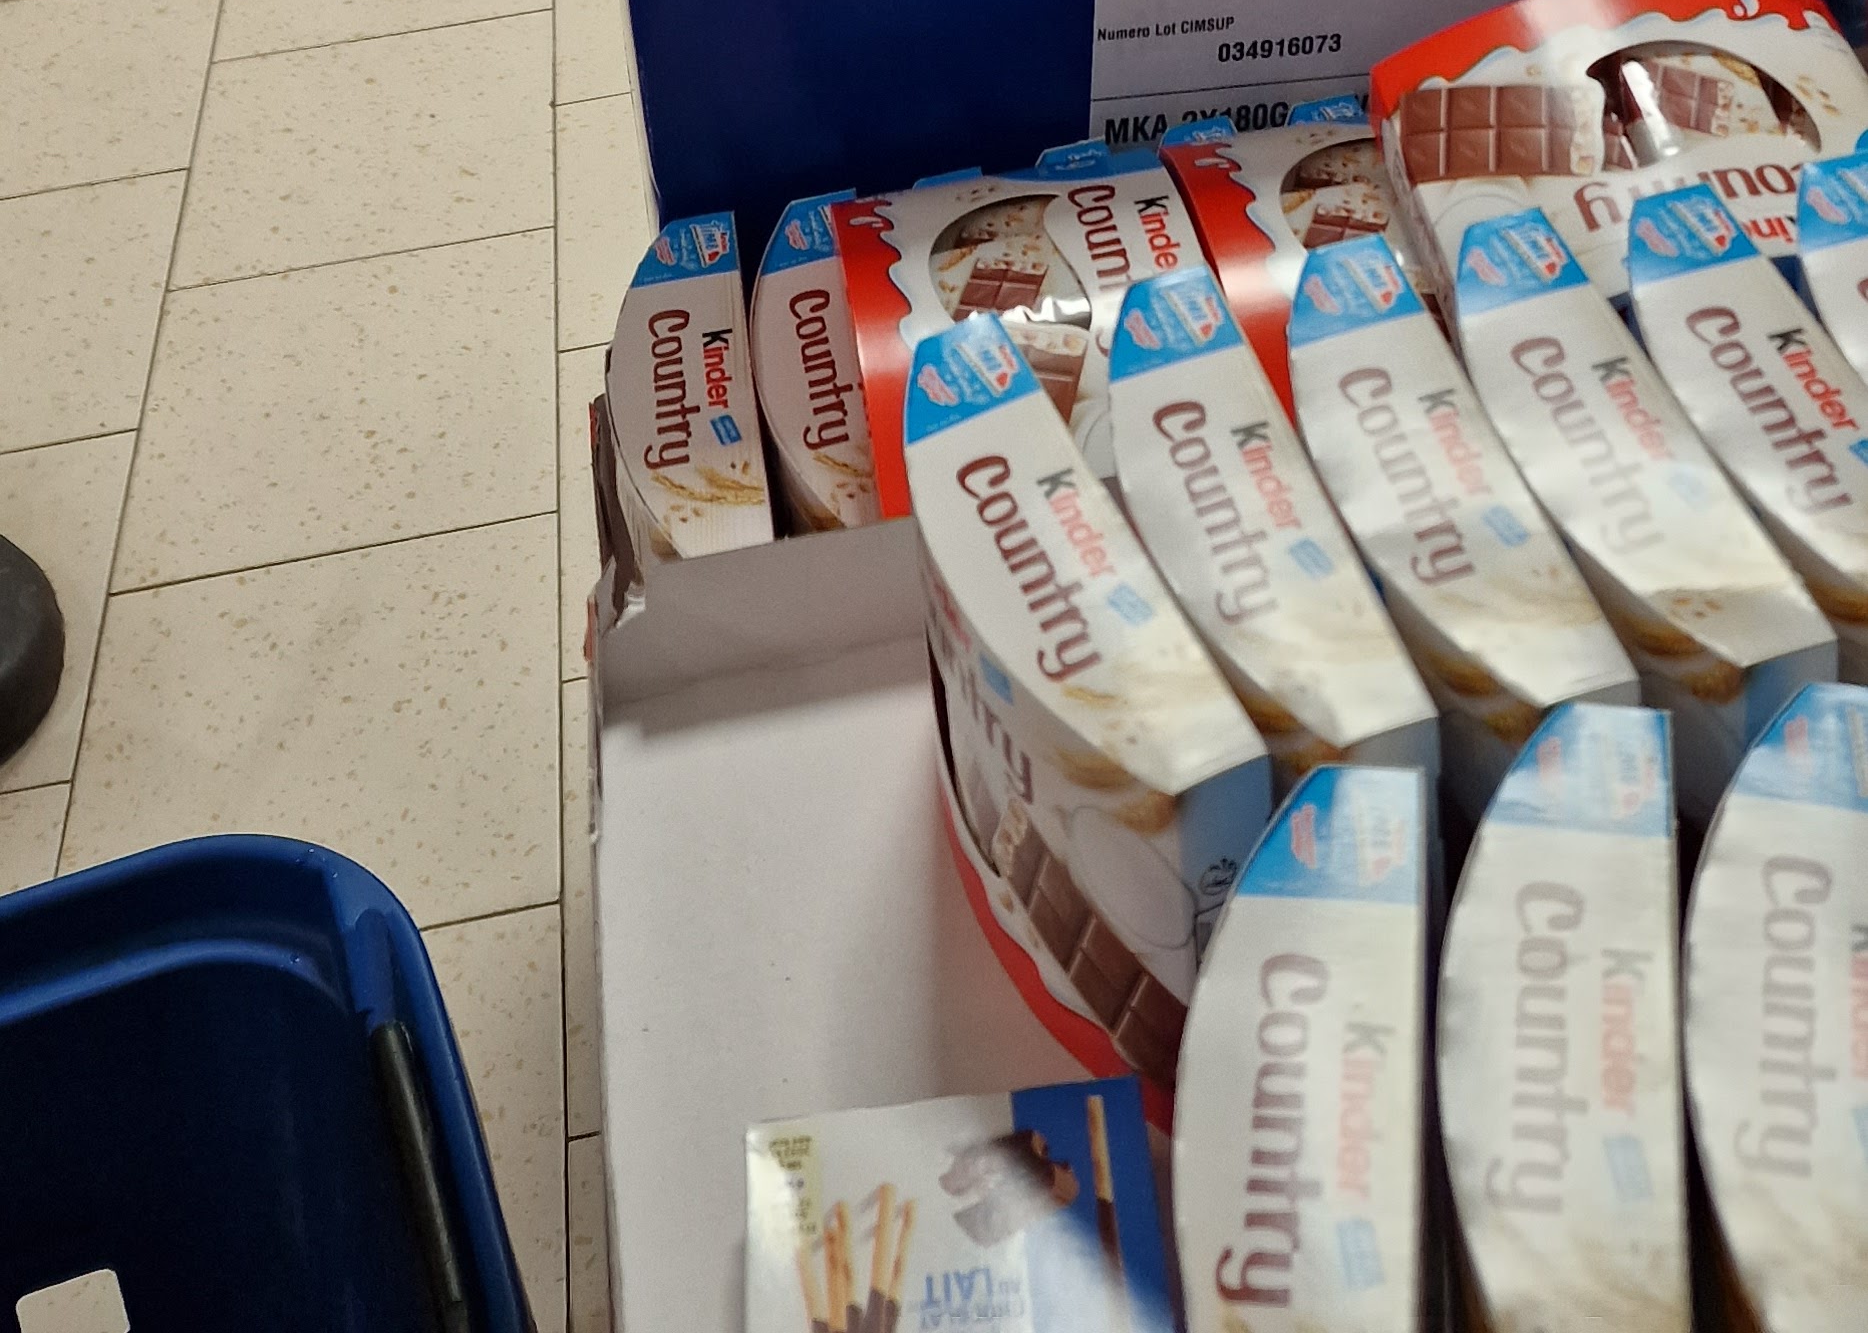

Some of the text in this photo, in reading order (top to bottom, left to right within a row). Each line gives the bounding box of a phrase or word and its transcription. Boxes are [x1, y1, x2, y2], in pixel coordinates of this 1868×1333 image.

[1096, 15, 1236, 42] Numero Lot CIMSUP
[1217, 32, 1343, 63] 034916073
[1104, 113, 1169, 146] MKA
[1133, 194, 1182, 271] Kinde
[643, 308, 701, 471] Country
[701, 328, 734, 410] Kinder
[788, 288, 855, 451] Country
[1591, 355, 1676, 462] Kinder
[1685, 304, 1854, 516] Country
[1767, 327, 1858, 433] Kinder
[1229, 421, 1302, 531] Kinder
[1337, 365, 1477, 587] Country
[1417, 387, 1492, 499] Kinder
[956, 454, 1104, 684] Country
[1035, 467, 1118, 580] Kinder
[1153, 400, 1279, 629] Country
[1485, 879, 1588, 1215] Country
[1215, 952, 1331, 1309] Country
